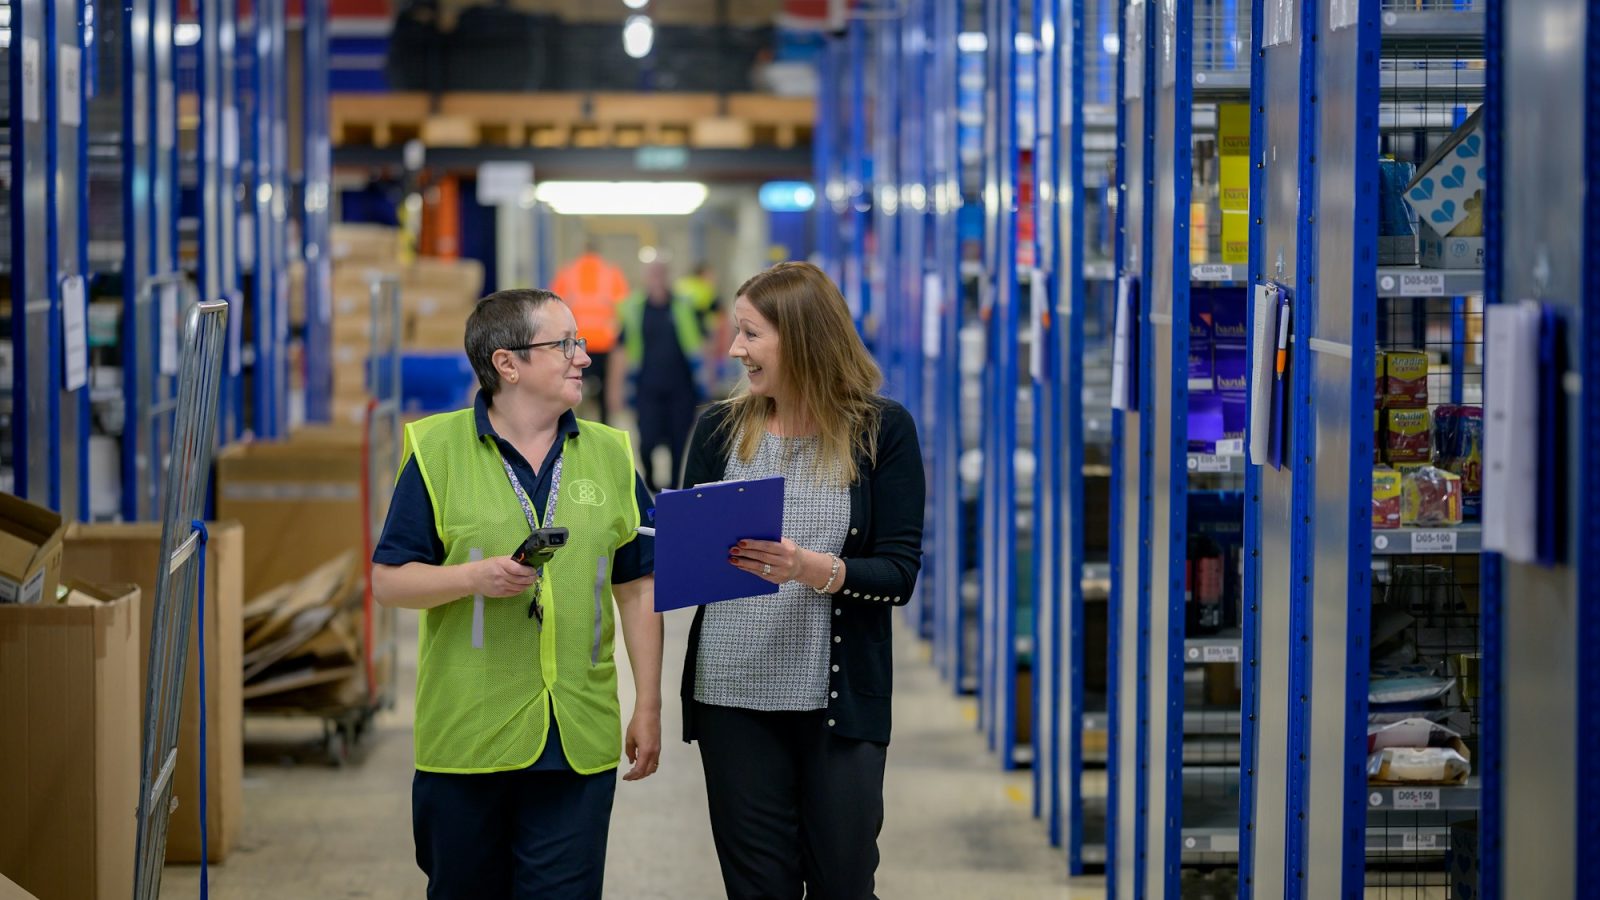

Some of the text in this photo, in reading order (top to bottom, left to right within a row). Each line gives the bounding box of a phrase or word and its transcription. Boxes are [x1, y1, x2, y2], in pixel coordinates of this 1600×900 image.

[1404, 275, 1439, 285] D05-050
[1416, 533, 1450, 543] D05-100
[1399, 791, 1433, 800] D05-150
